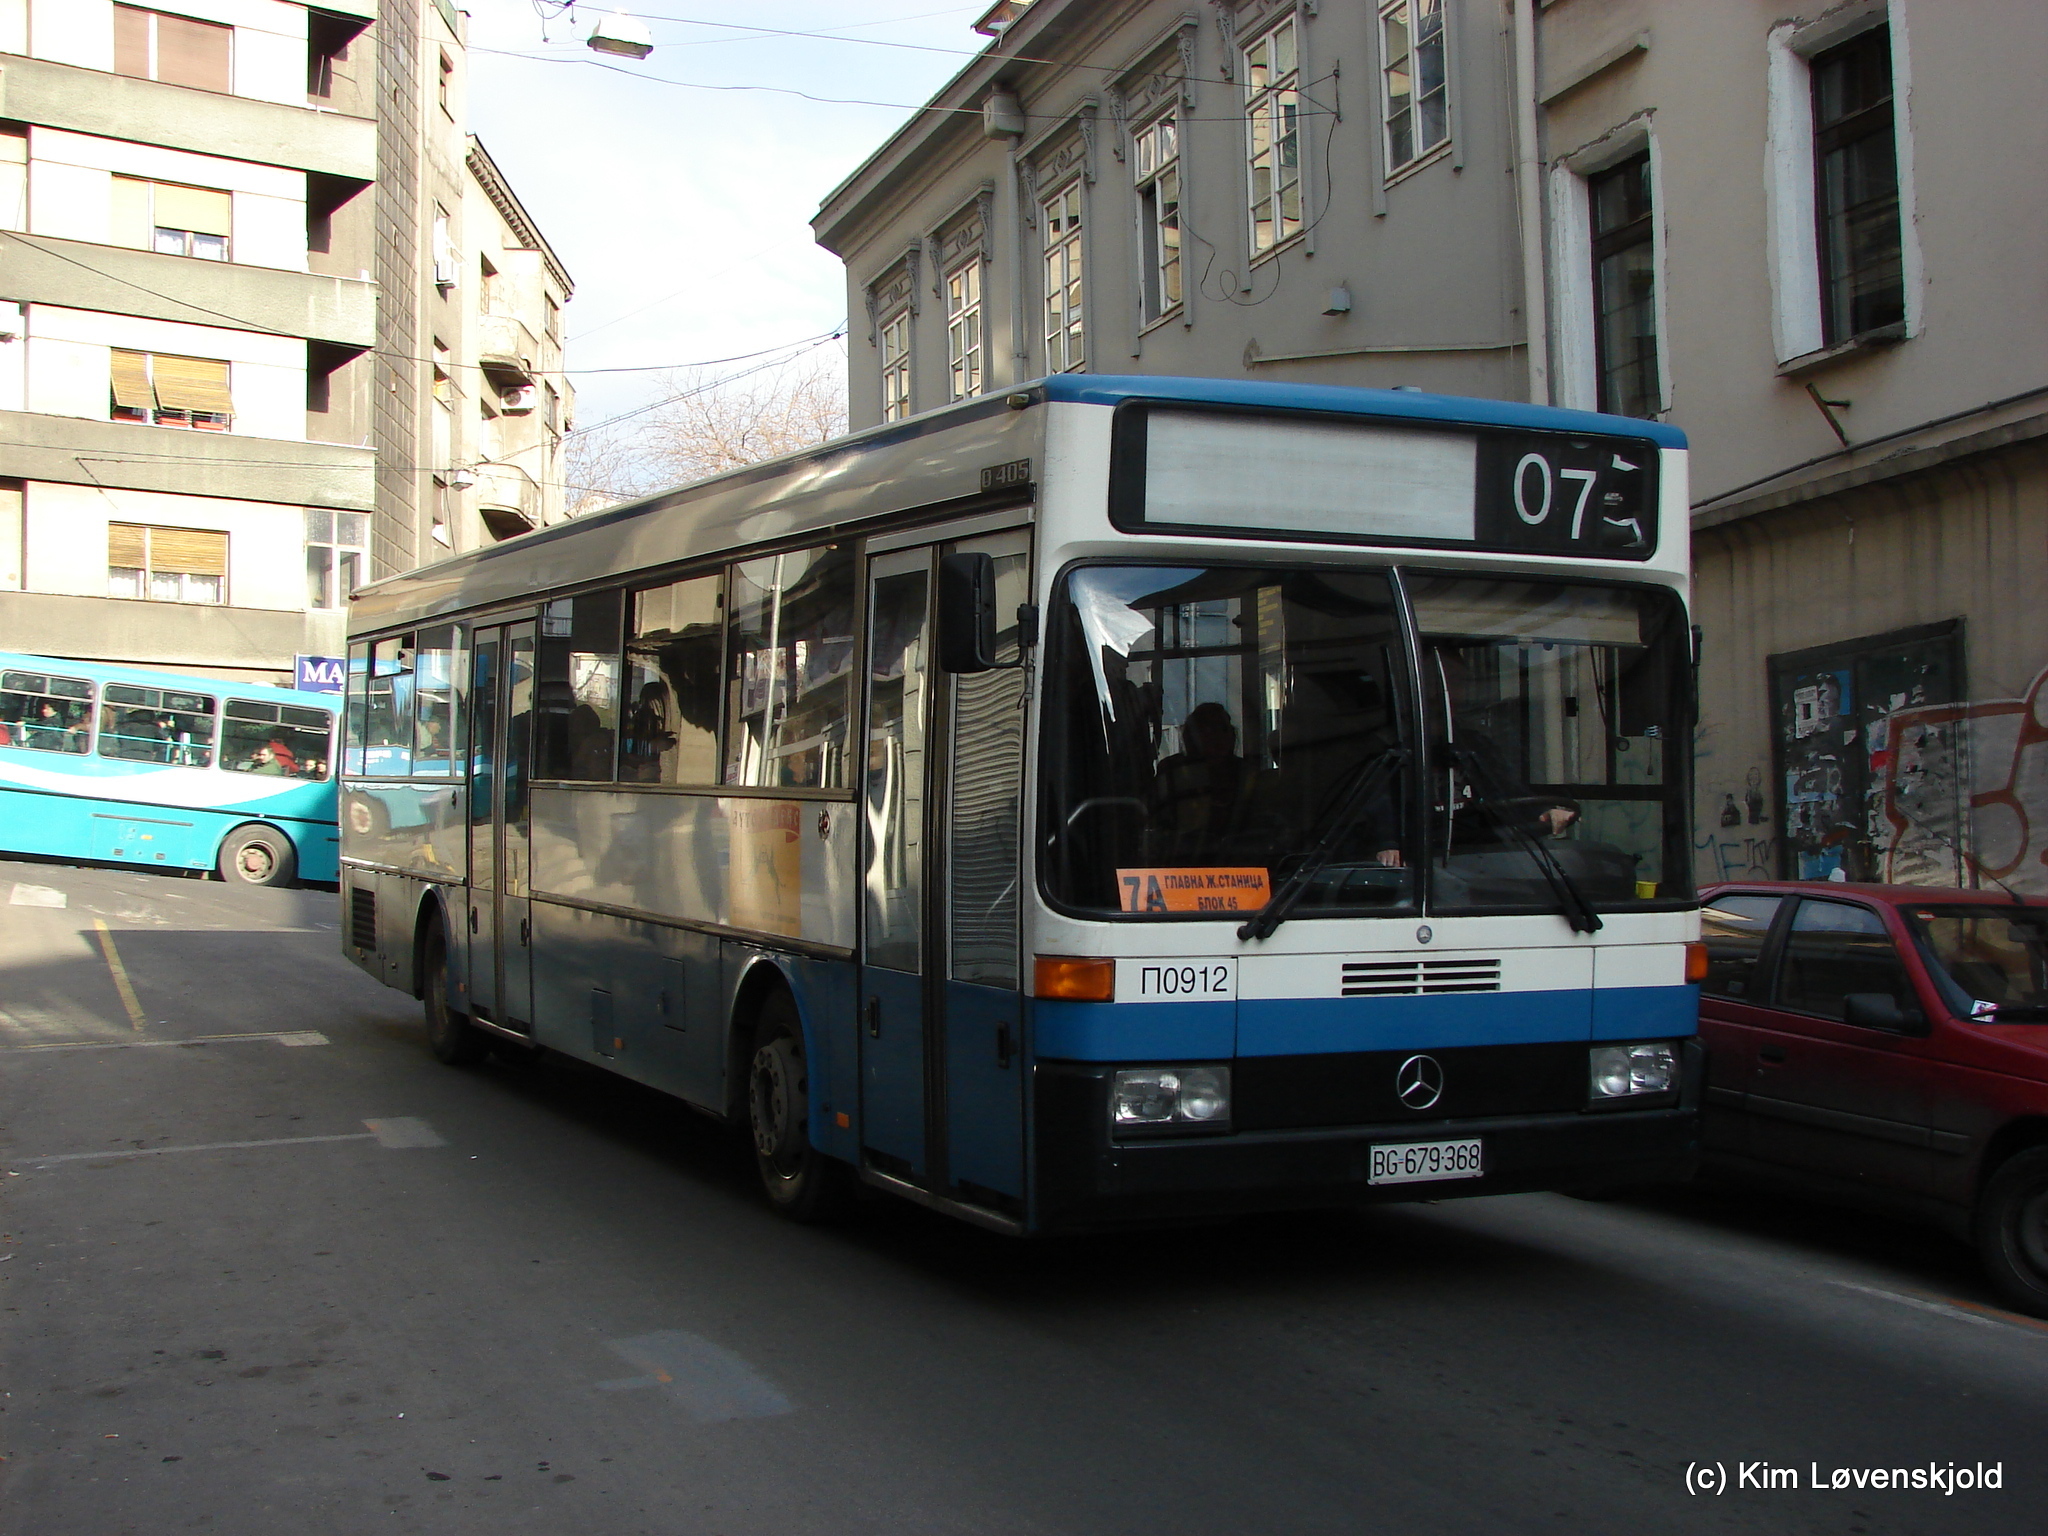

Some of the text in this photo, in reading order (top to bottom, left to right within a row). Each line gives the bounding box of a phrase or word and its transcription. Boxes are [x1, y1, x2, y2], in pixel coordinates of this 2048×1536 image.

[995, 461, 1029, 484] 405
[1164, 875, 1203, 889] ГЛАВНА
[1198, 896, 1238, 910] БЛОК 45
